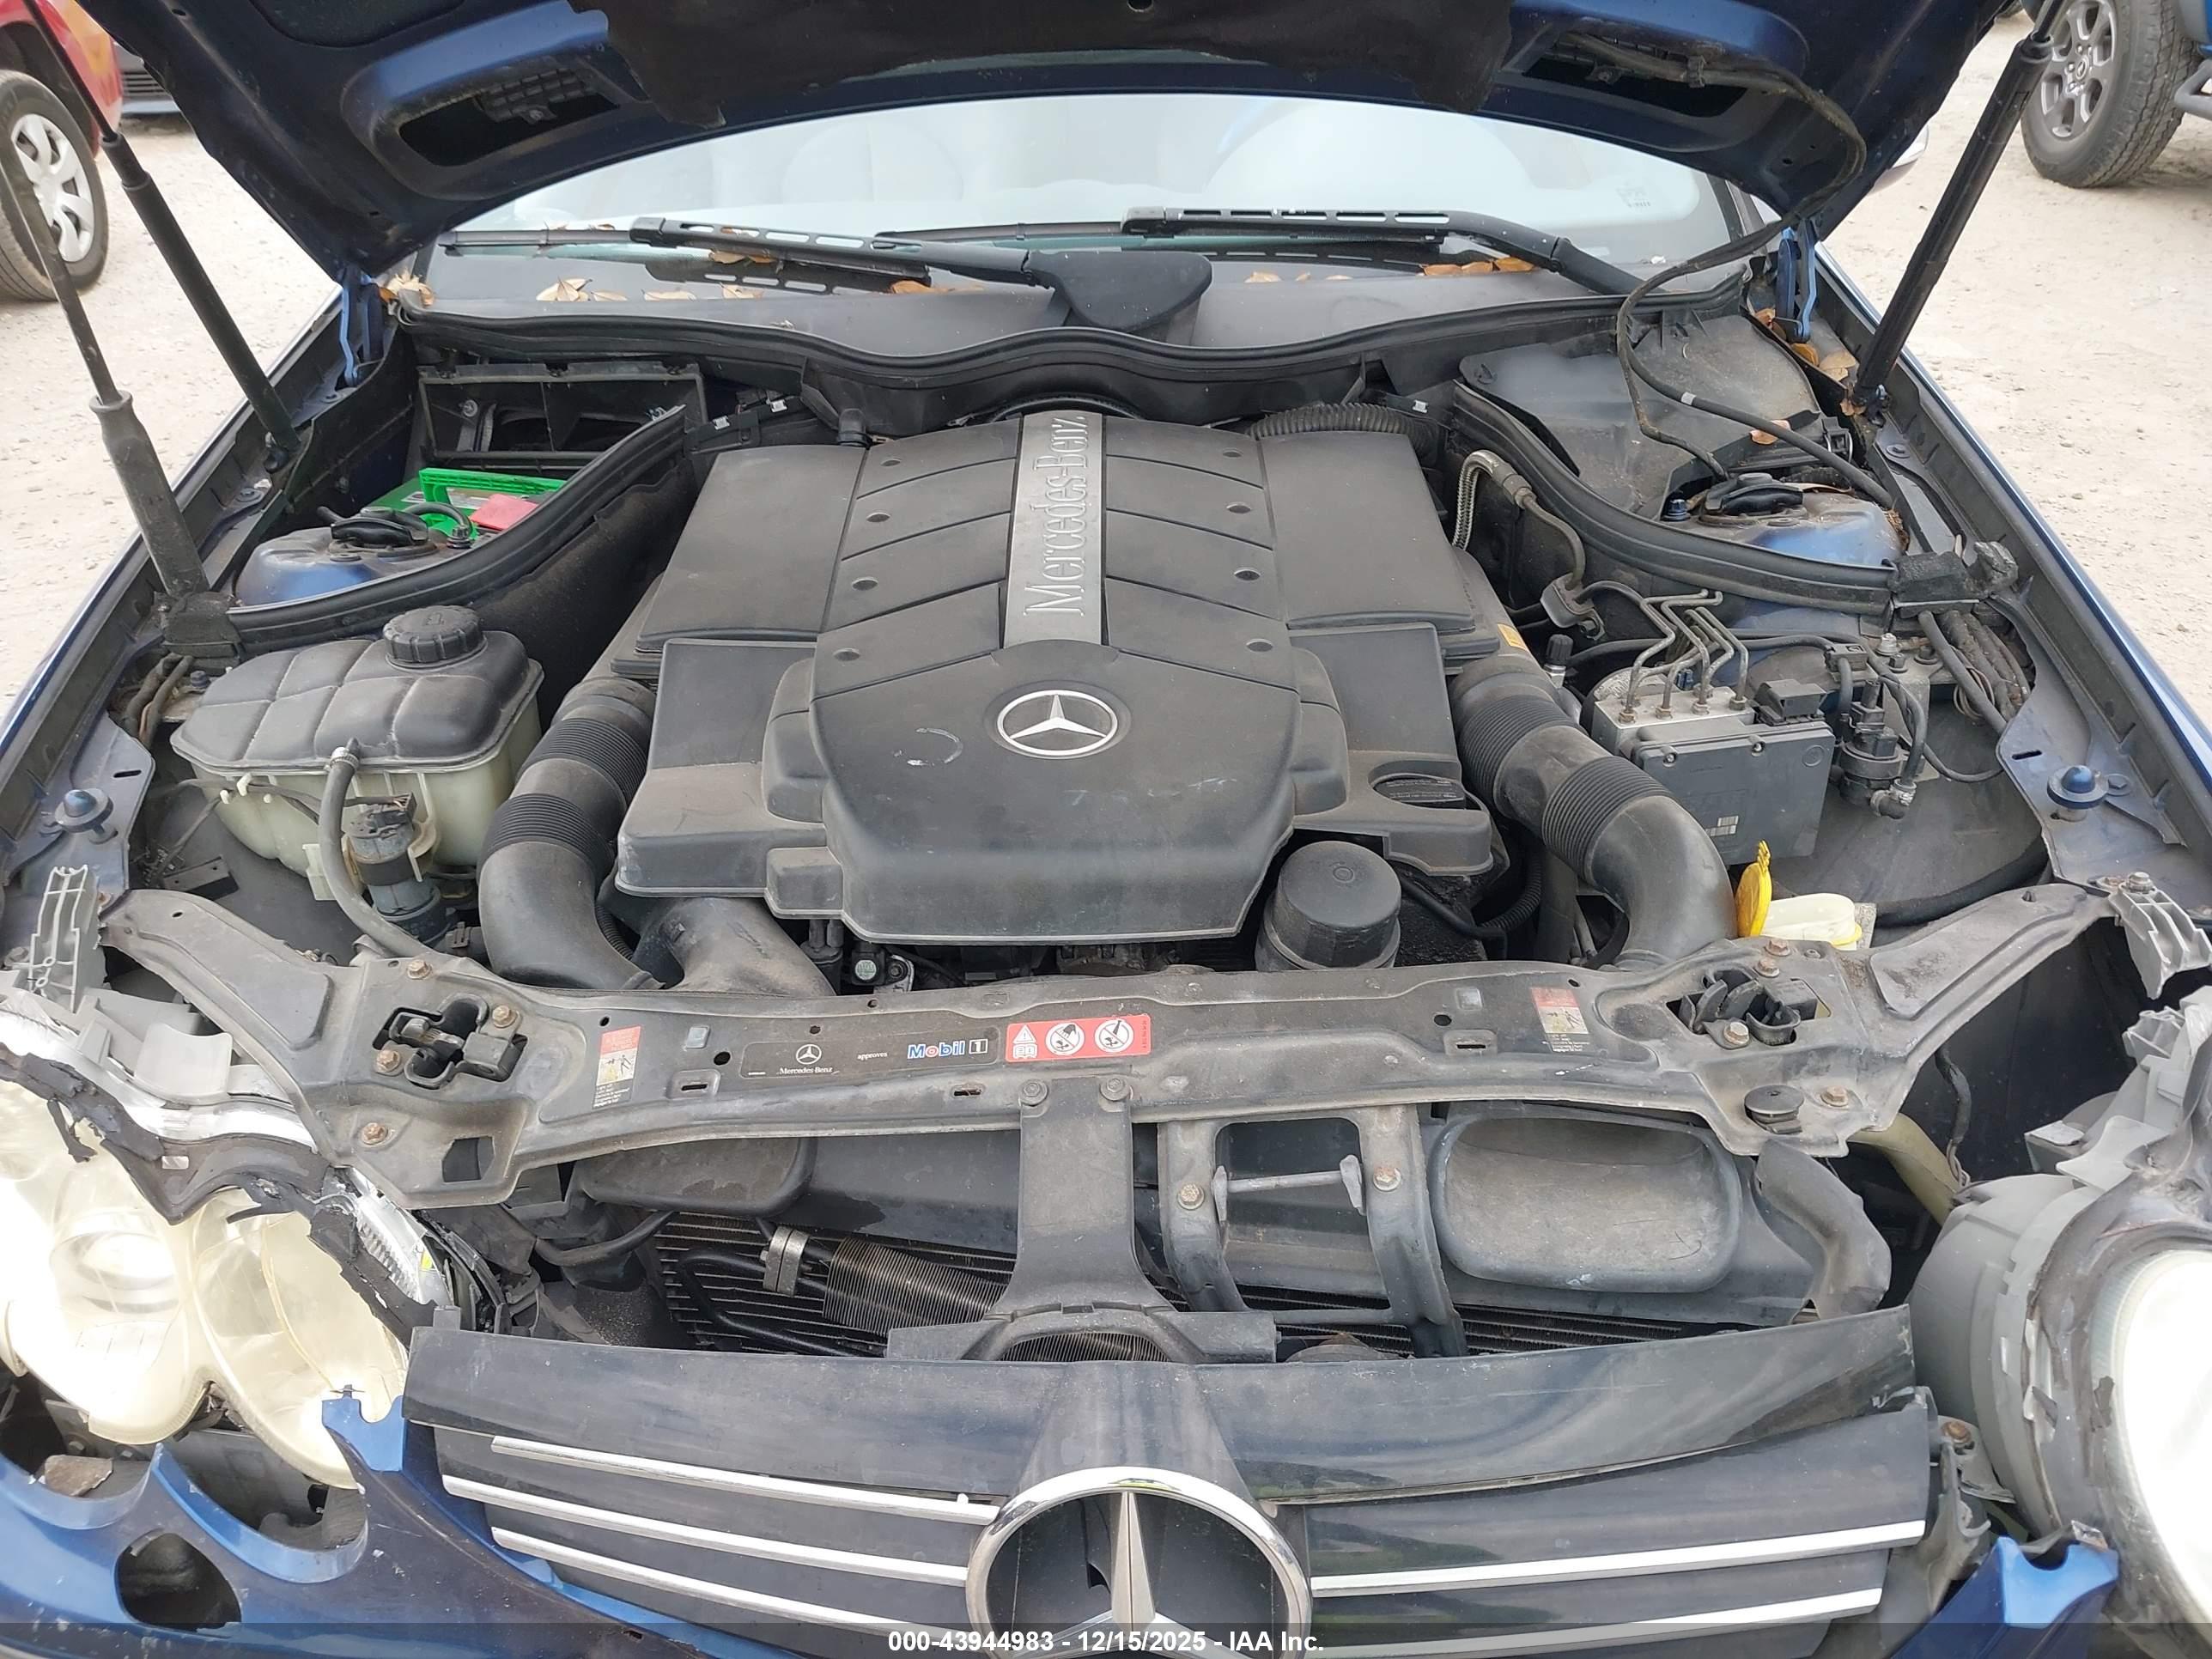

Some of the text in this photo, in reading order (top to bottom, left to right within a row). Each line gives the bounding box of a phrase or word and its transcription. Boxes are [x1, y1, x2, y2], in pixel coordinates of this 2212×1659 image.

[1024, 416, 1088, 616] Mercedes-Benz
[857, 1052, 888, 1060] approves
[907, 1041, 965, 1060] Mobil
